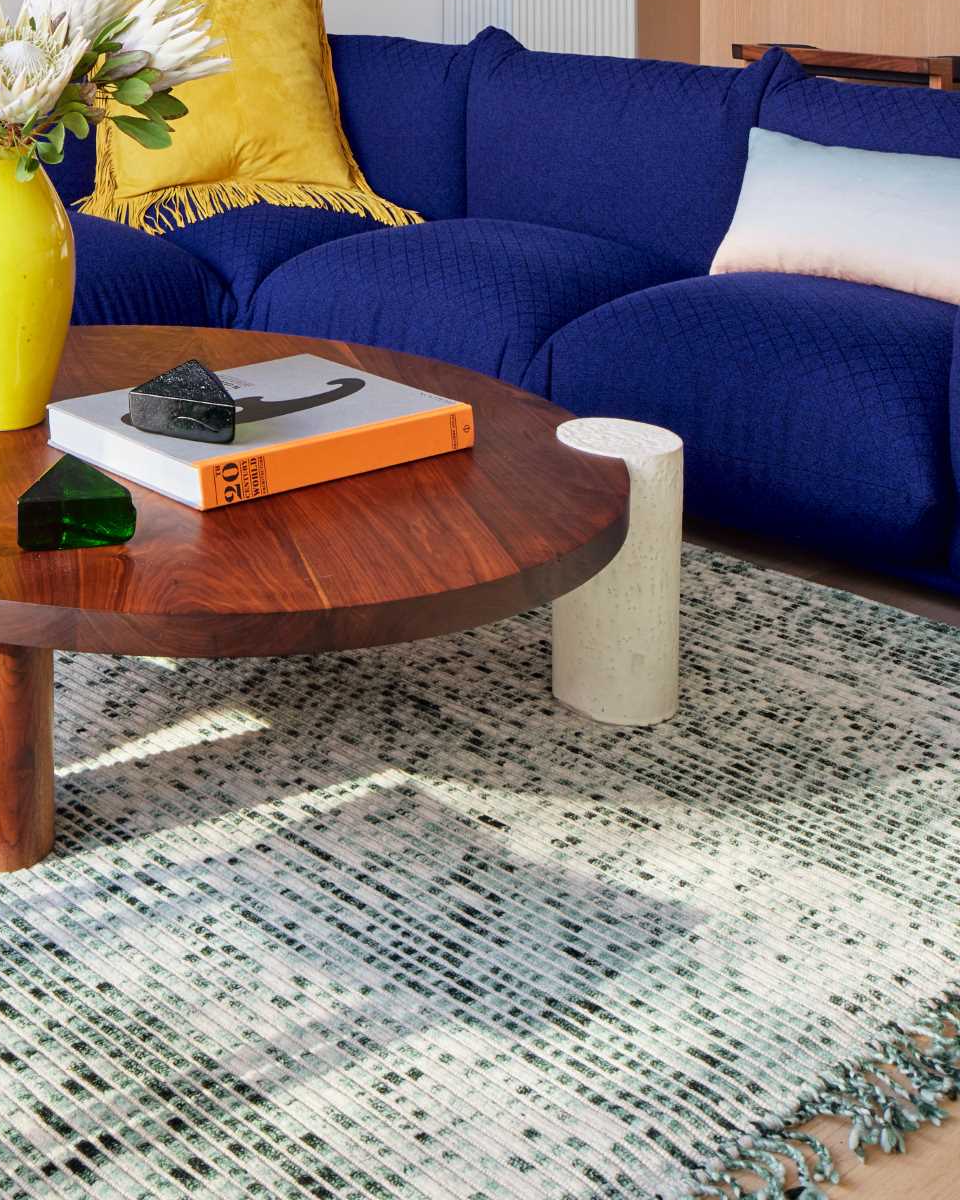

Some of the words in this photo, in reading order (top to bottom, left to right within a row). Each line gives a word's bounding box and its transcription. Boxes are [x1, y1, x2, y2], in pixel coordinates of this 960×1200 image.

[222, 462, 242, 503] 20
[241, 460, 250, 498] CENTURY
[250, 457, 260, 497] WORLD
